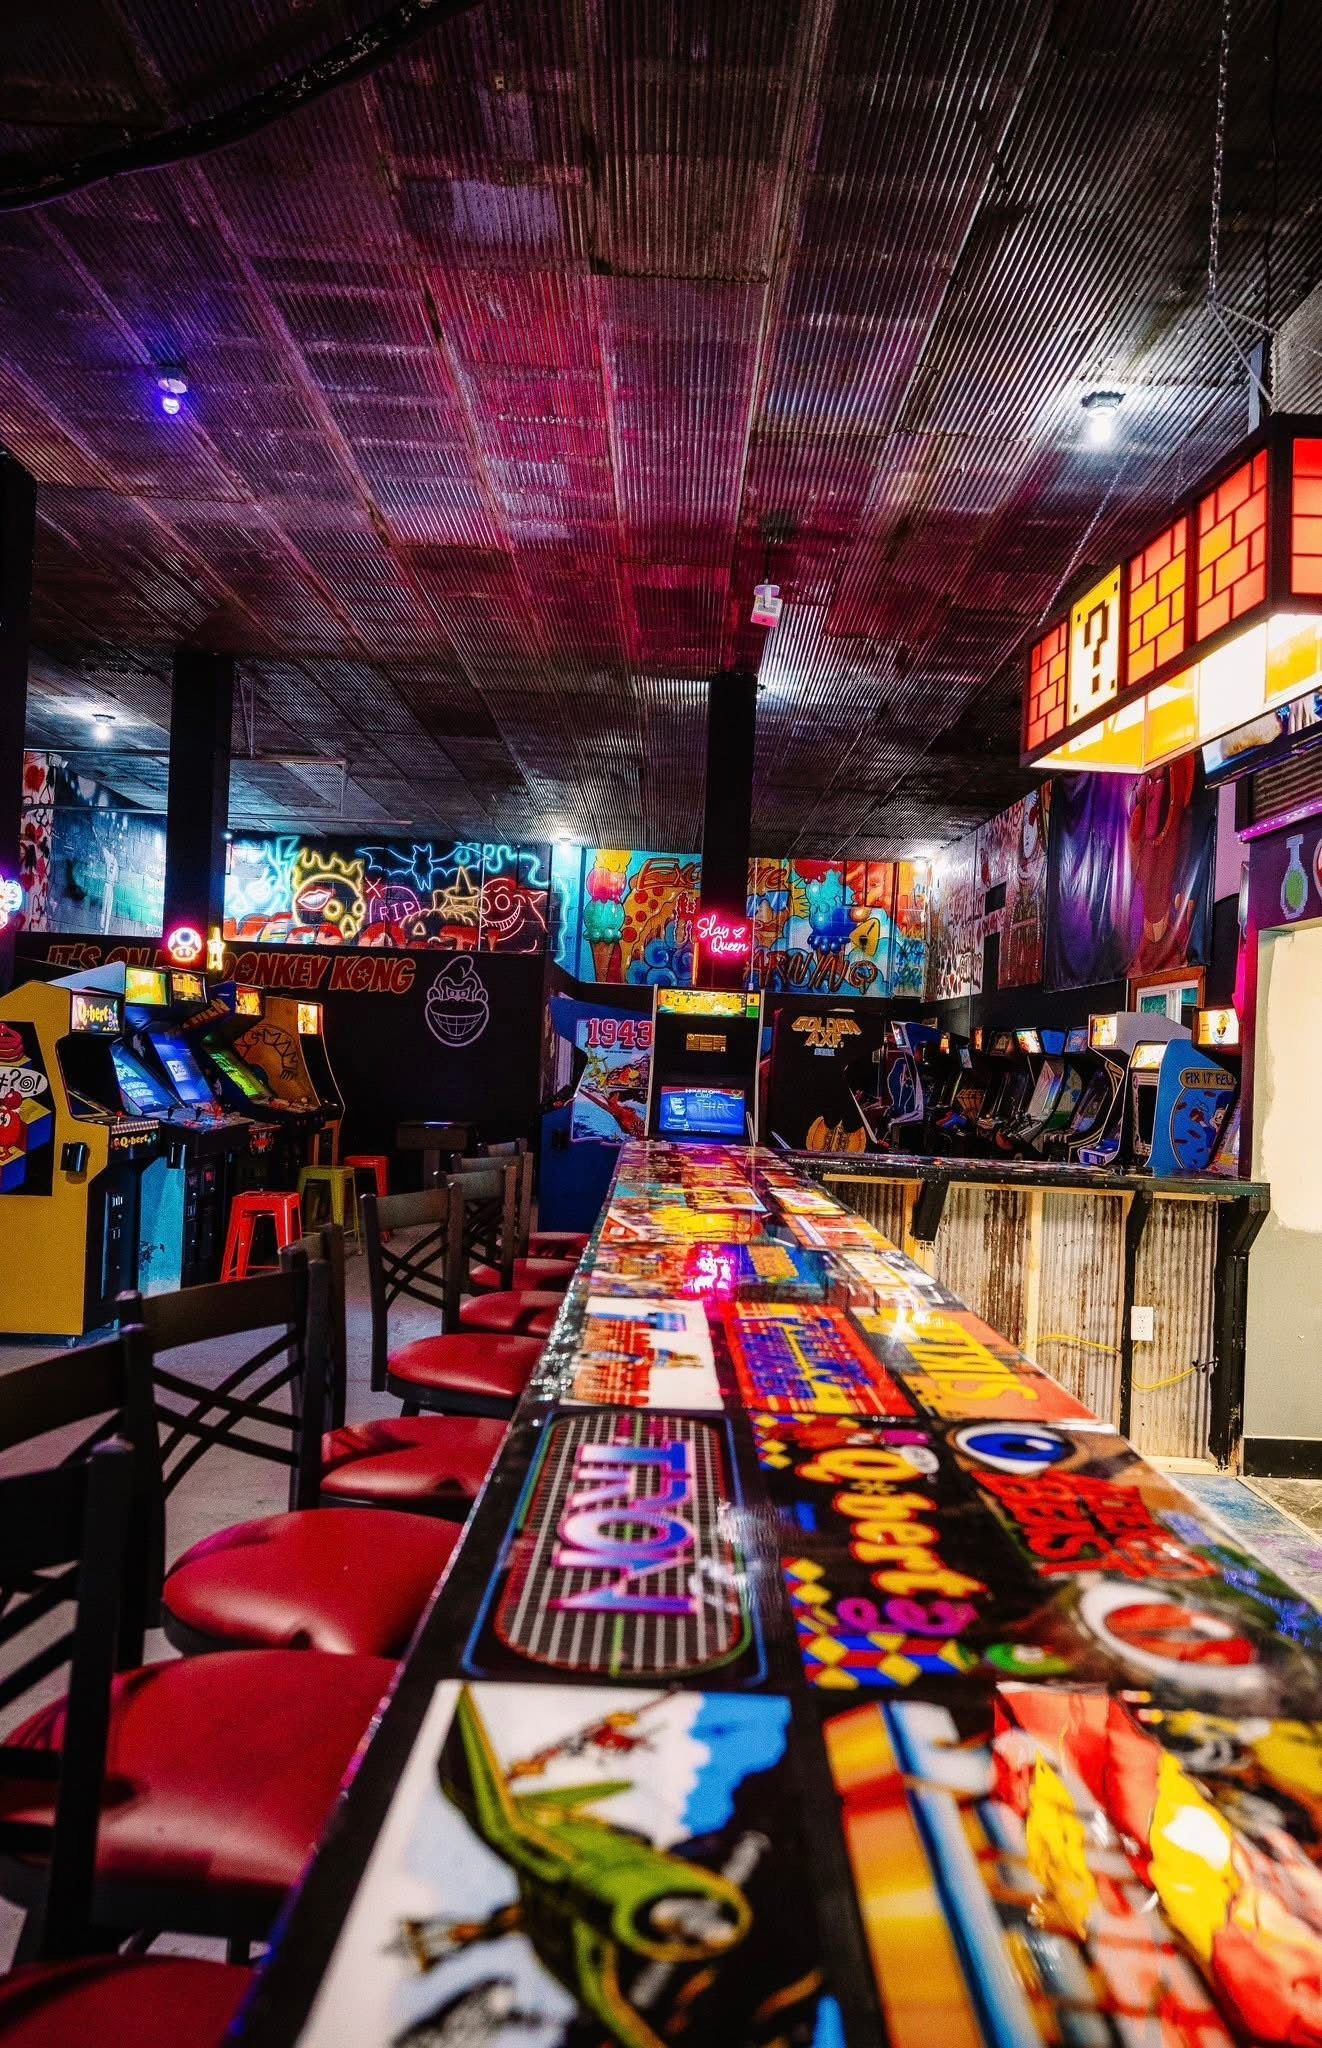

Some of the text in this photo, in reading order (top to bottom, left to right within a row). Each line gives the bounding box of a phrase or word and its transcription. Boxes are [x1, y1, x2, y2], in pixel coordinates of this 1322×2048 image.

[379, 901, 415, 921] RIP
[696, 914, 729, 939] Slay
[711, 936, 749, 953] Queen
[221, 950, 331, 989] DONKEY
[328, 955, 417, 994] KONG
[588, 1018, 654, 1048] 1943
[791, 1016, 862, 1035] GOLDEN
[804, 1030, 844, 1048] AXE
[1185, 1072, 1200, 1083] FIX
[547, 1441, 698, 1614] TRON
